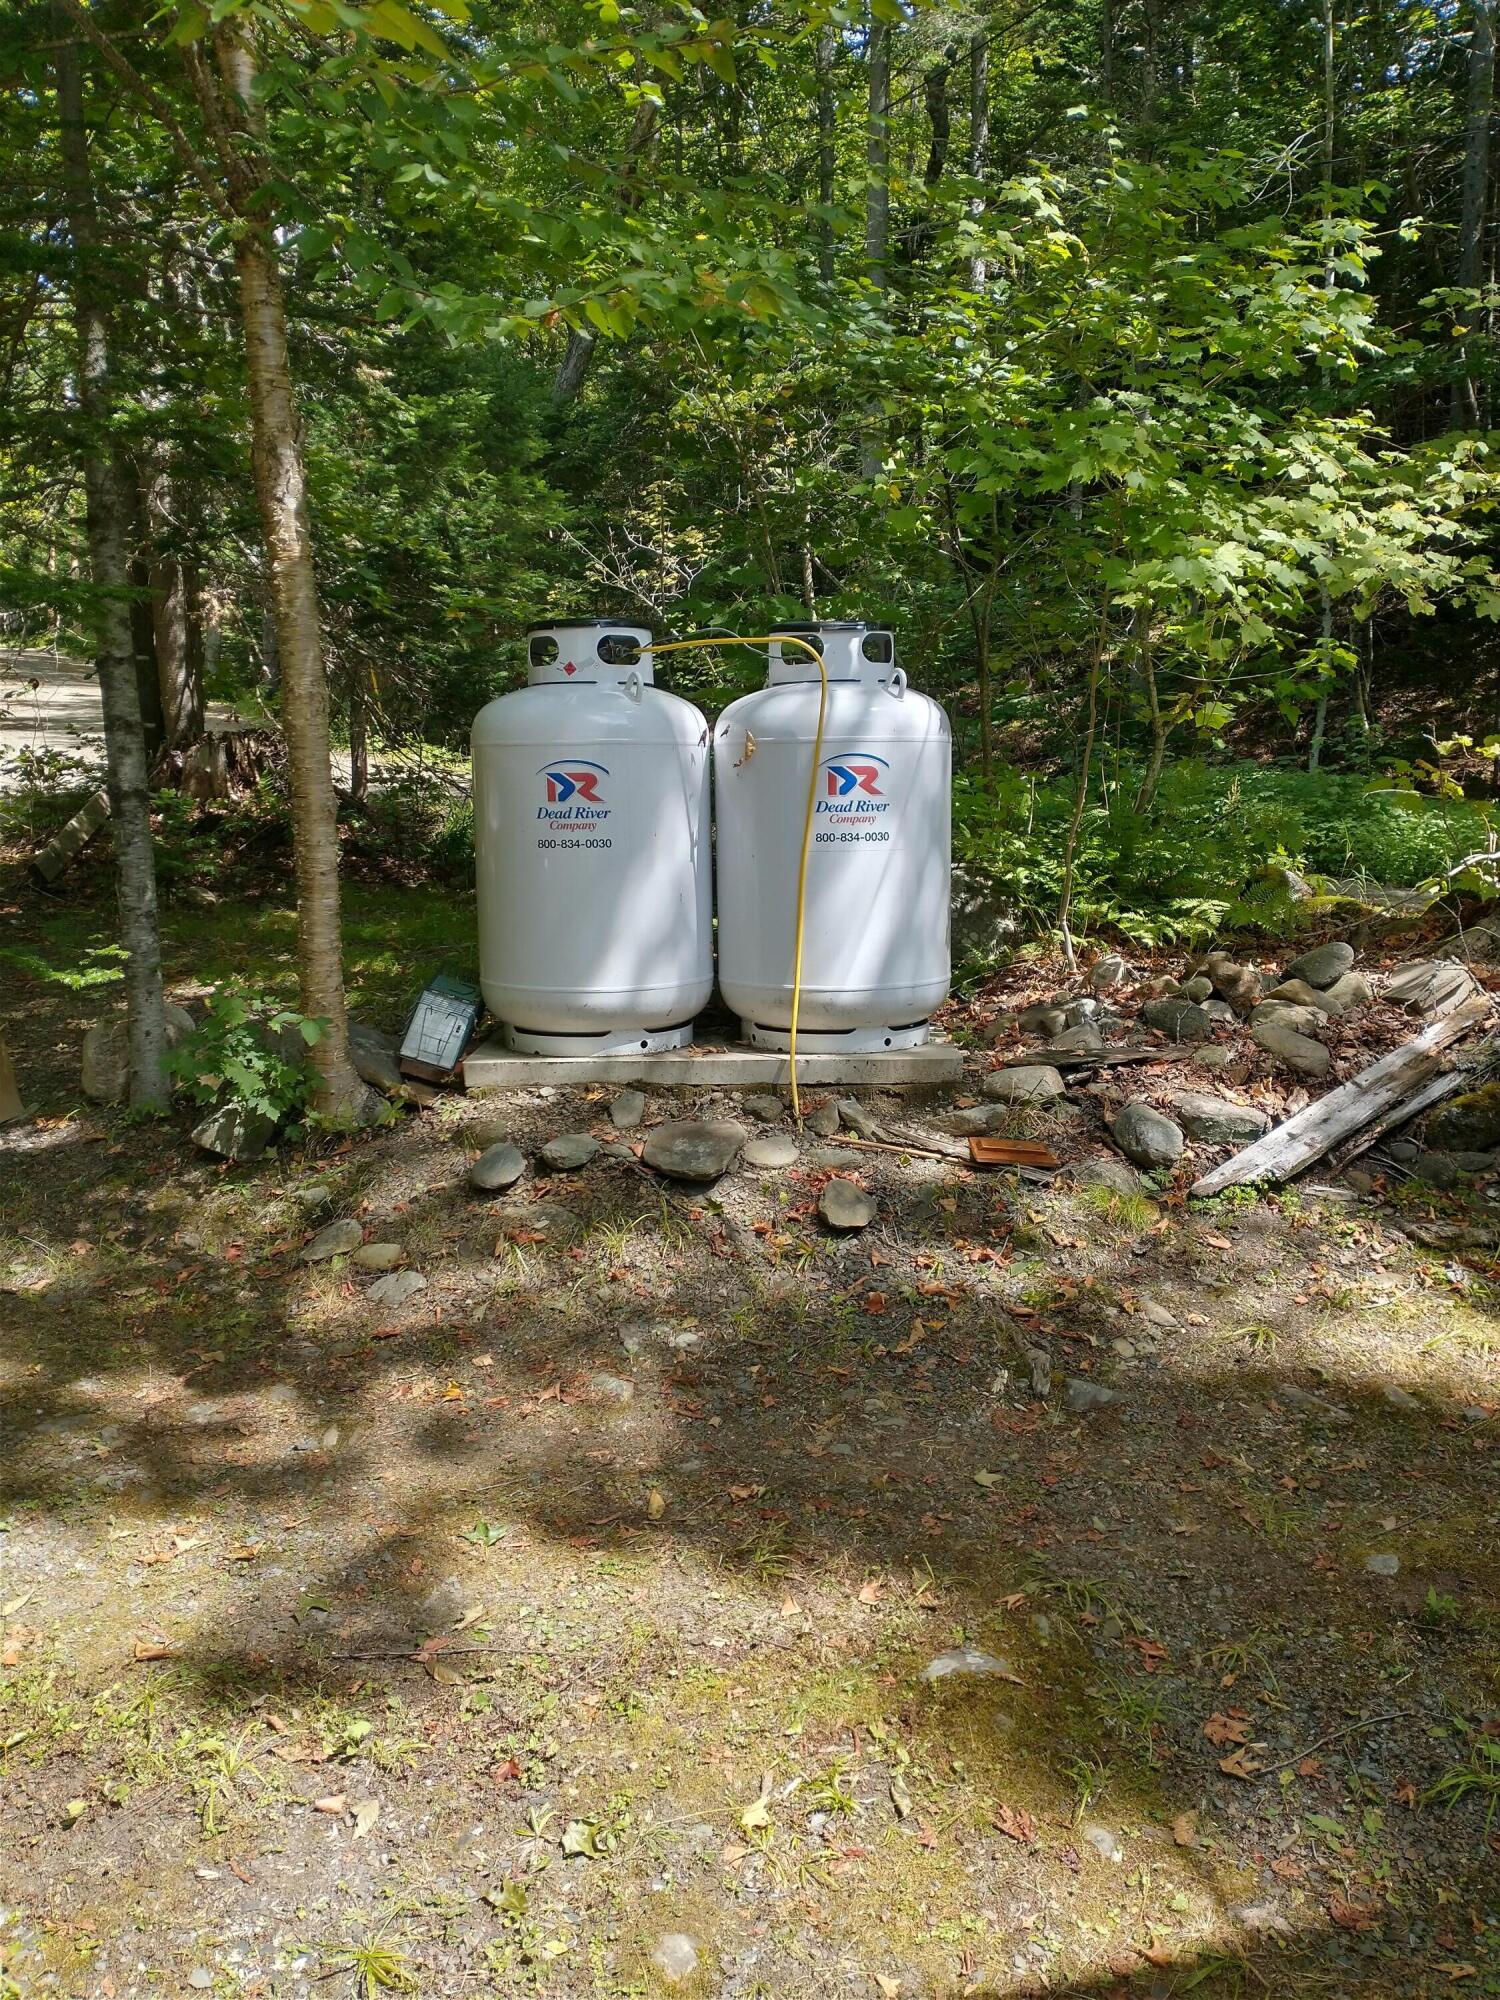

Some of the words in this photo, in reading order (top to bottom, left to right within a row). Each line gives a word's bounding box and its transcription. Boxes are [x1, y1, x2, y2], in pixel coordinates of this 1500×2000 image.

[815, 800, 853, 813] Dead
[855, 800, 890, 813] River
[536, 807, 573, 819] Dead
[574, 807, 612, 819] River
[549, 820, 597, 832] Company
[829, 814, 876, 826] Company
[537, 838, 612, 849] 800-834-0030
[815, 832, 890, 843] 800-834-0030
